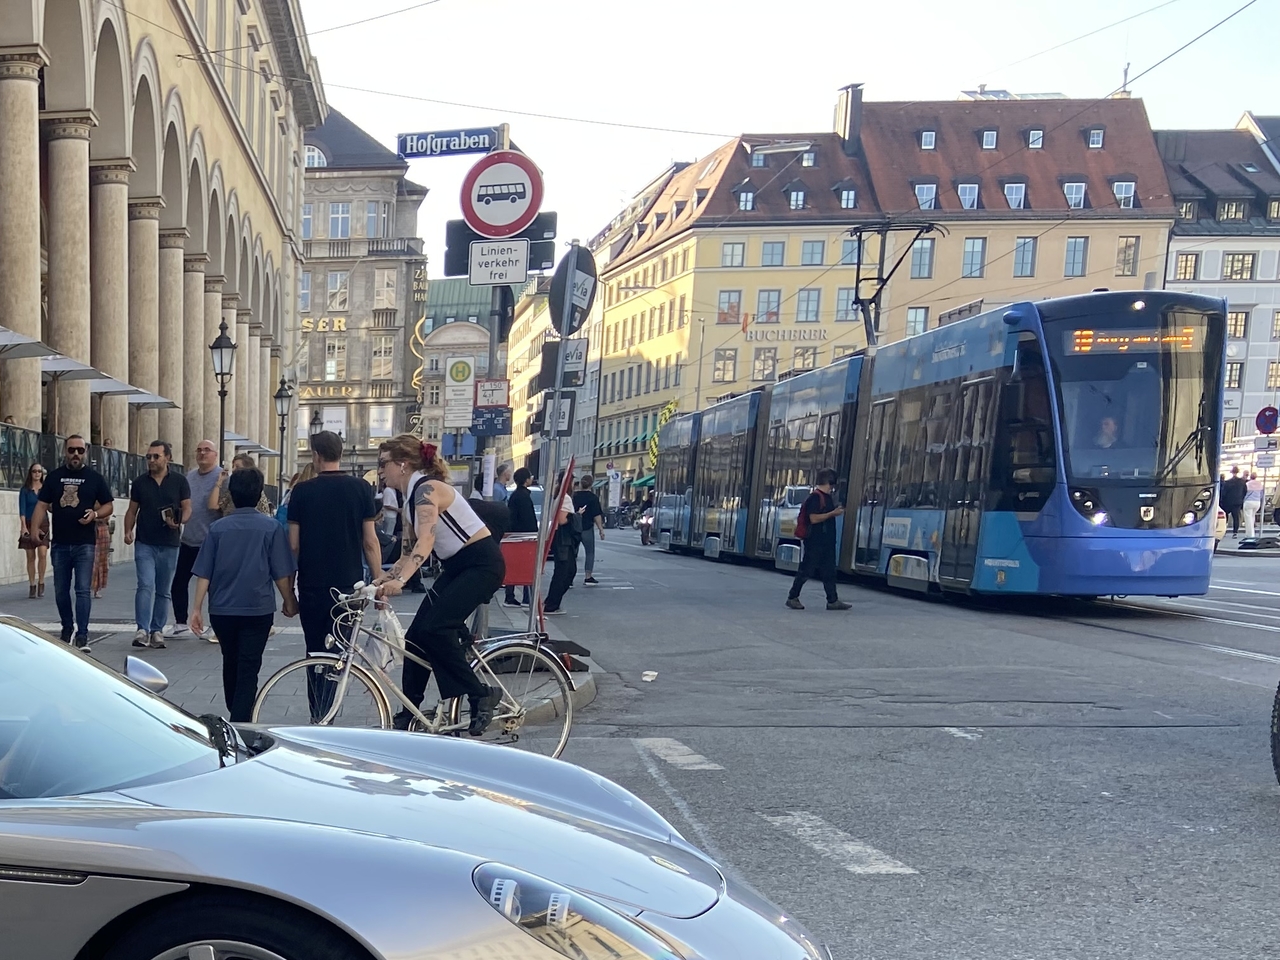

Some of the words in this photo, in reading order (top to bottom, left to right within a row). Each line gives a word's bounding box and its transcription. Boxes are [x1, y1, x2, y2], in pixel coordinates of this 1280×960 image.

[406, 131, 490, 155] Hofgraben
[480, 245, 519, 257] Linien-
[478, 257, 520, 269] verkehr
[489, 269, 508, 280] frei
[745, 328, 829, 342] BUCHERER
